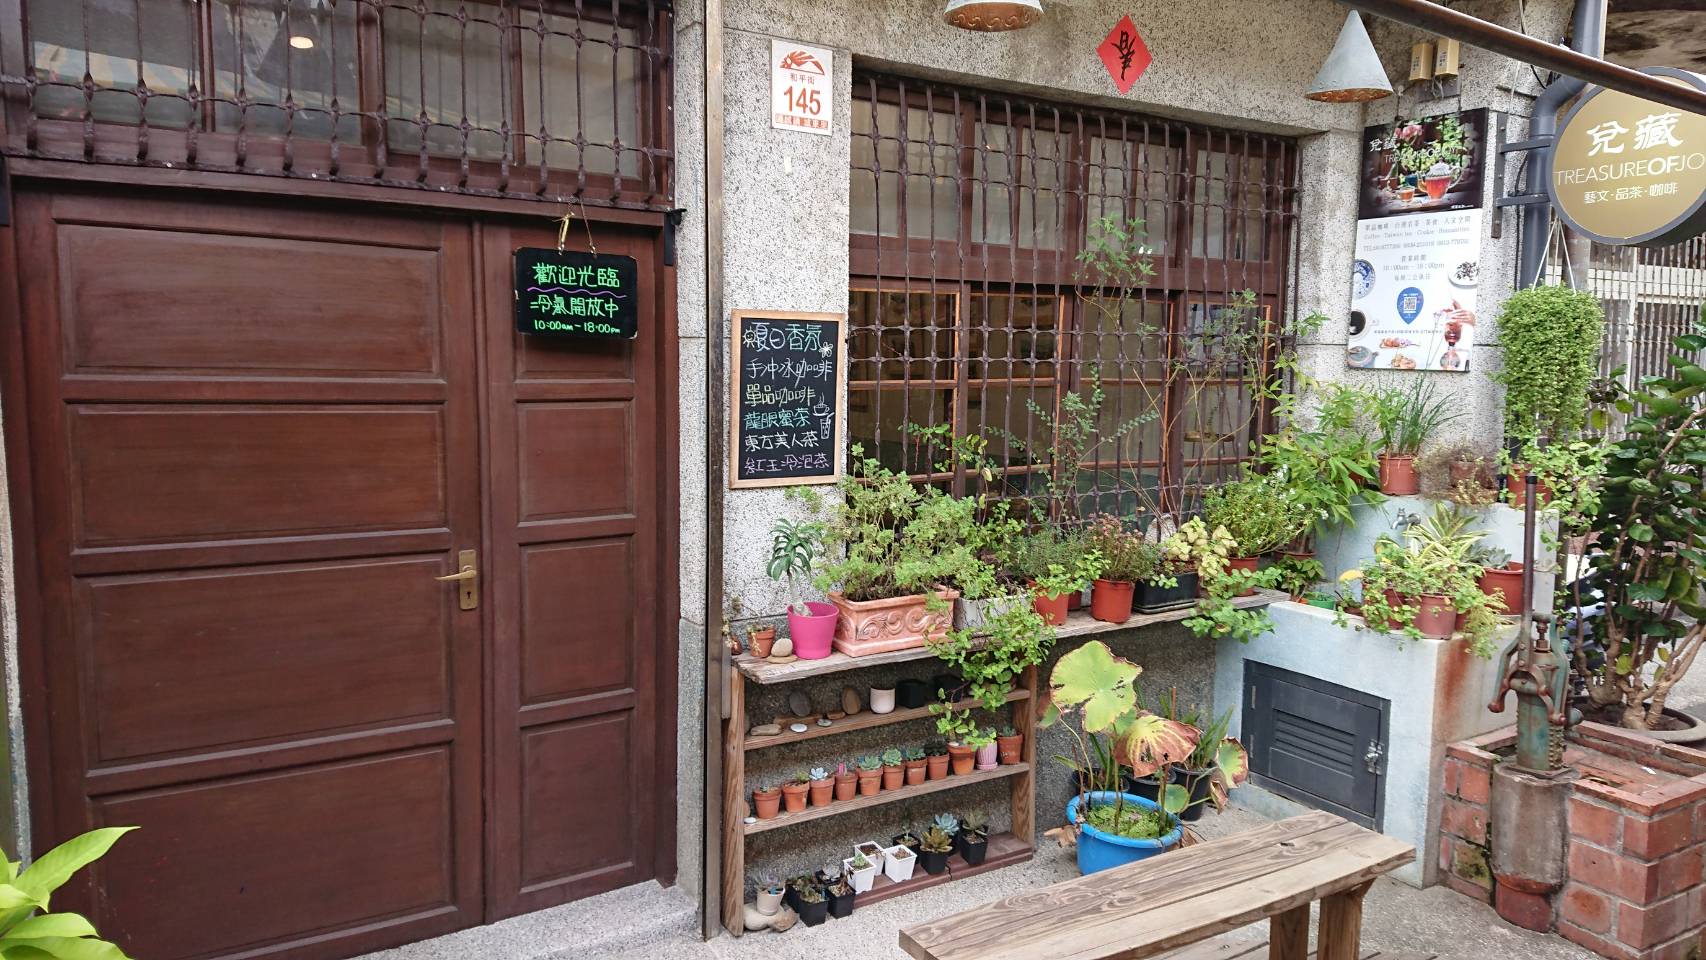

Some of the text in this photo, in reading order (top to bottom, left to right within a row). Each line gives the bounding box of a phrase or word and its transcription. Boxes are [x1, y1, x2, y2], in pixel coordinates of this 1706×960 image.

[790, 72, 815, 85] 和平街
[783, 85, 821, 116] 145
[531, 262, 620, 288] 歡迎光臨
[529, 294, 619, 319] 冷氣開放中
[744, 383, 817, 407] 單品咖啡
[744, 430, 820, 453] 東方美人茶
